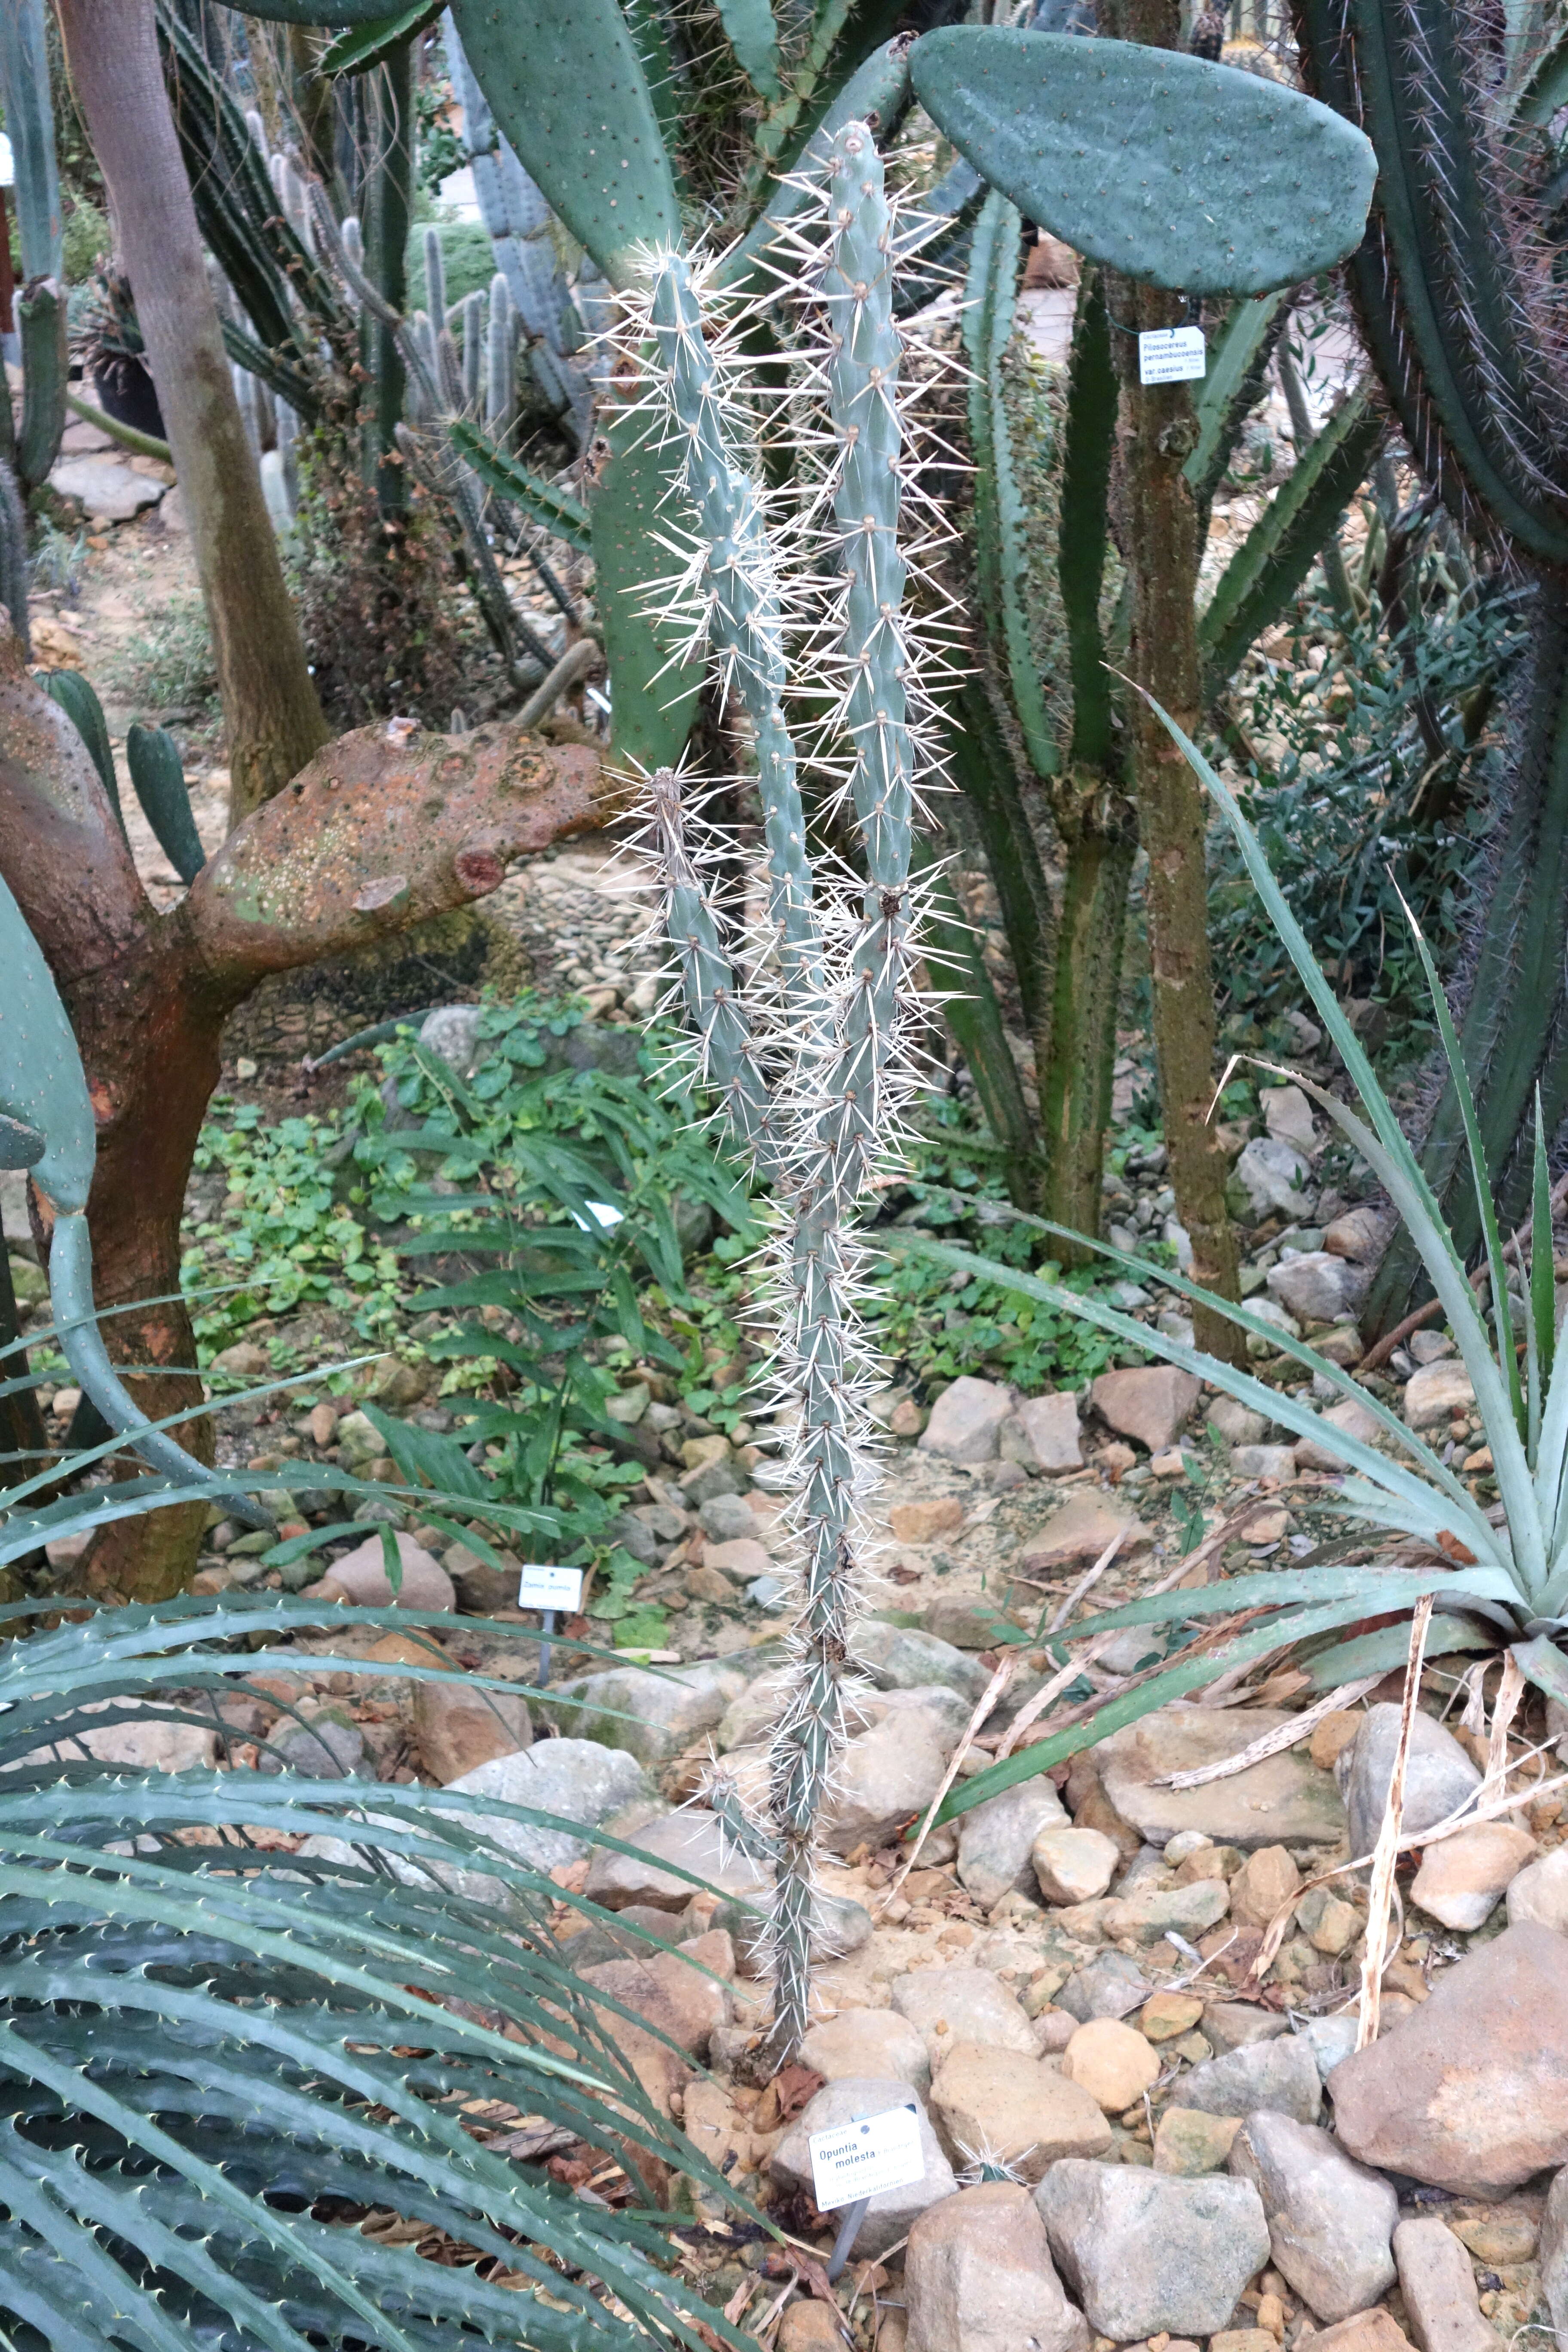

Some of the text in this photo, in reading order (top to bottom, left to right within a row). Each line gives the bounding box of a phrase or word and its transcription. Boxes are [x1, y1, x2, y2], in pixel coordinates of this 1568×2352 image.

[1144, 342, 1187, 351] Pilosocereus
[819, 2142, 858, 2161] Opuntia
[835, 2151, 876, 2169] molesta
